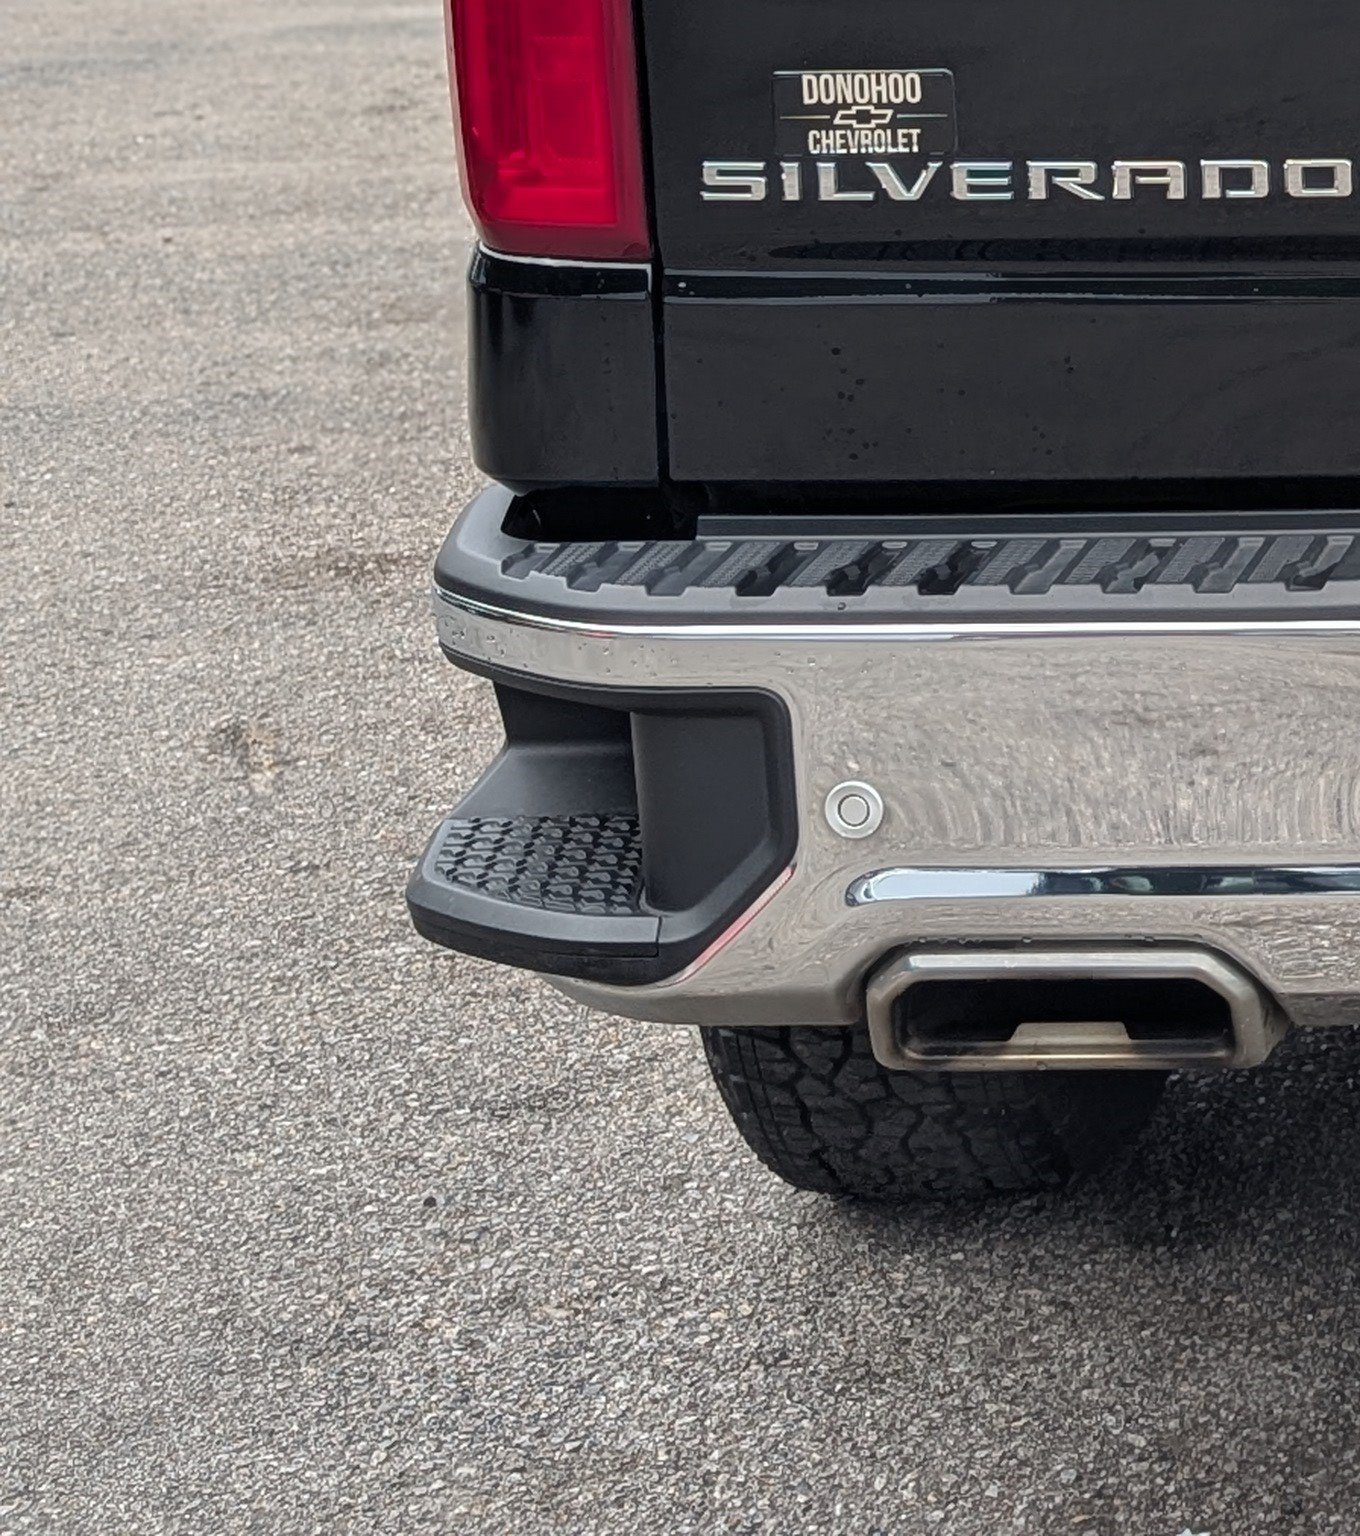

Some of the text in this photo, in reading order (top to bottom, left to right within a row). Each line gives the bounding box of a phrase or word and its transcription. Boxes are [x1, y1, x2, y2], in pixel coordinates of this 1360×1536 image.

[802, 73, 922, 105] DONOHOO
[808, 128, 921, 154] CHEVROLET
[700, 159, 1353, 202] SILVERADO
